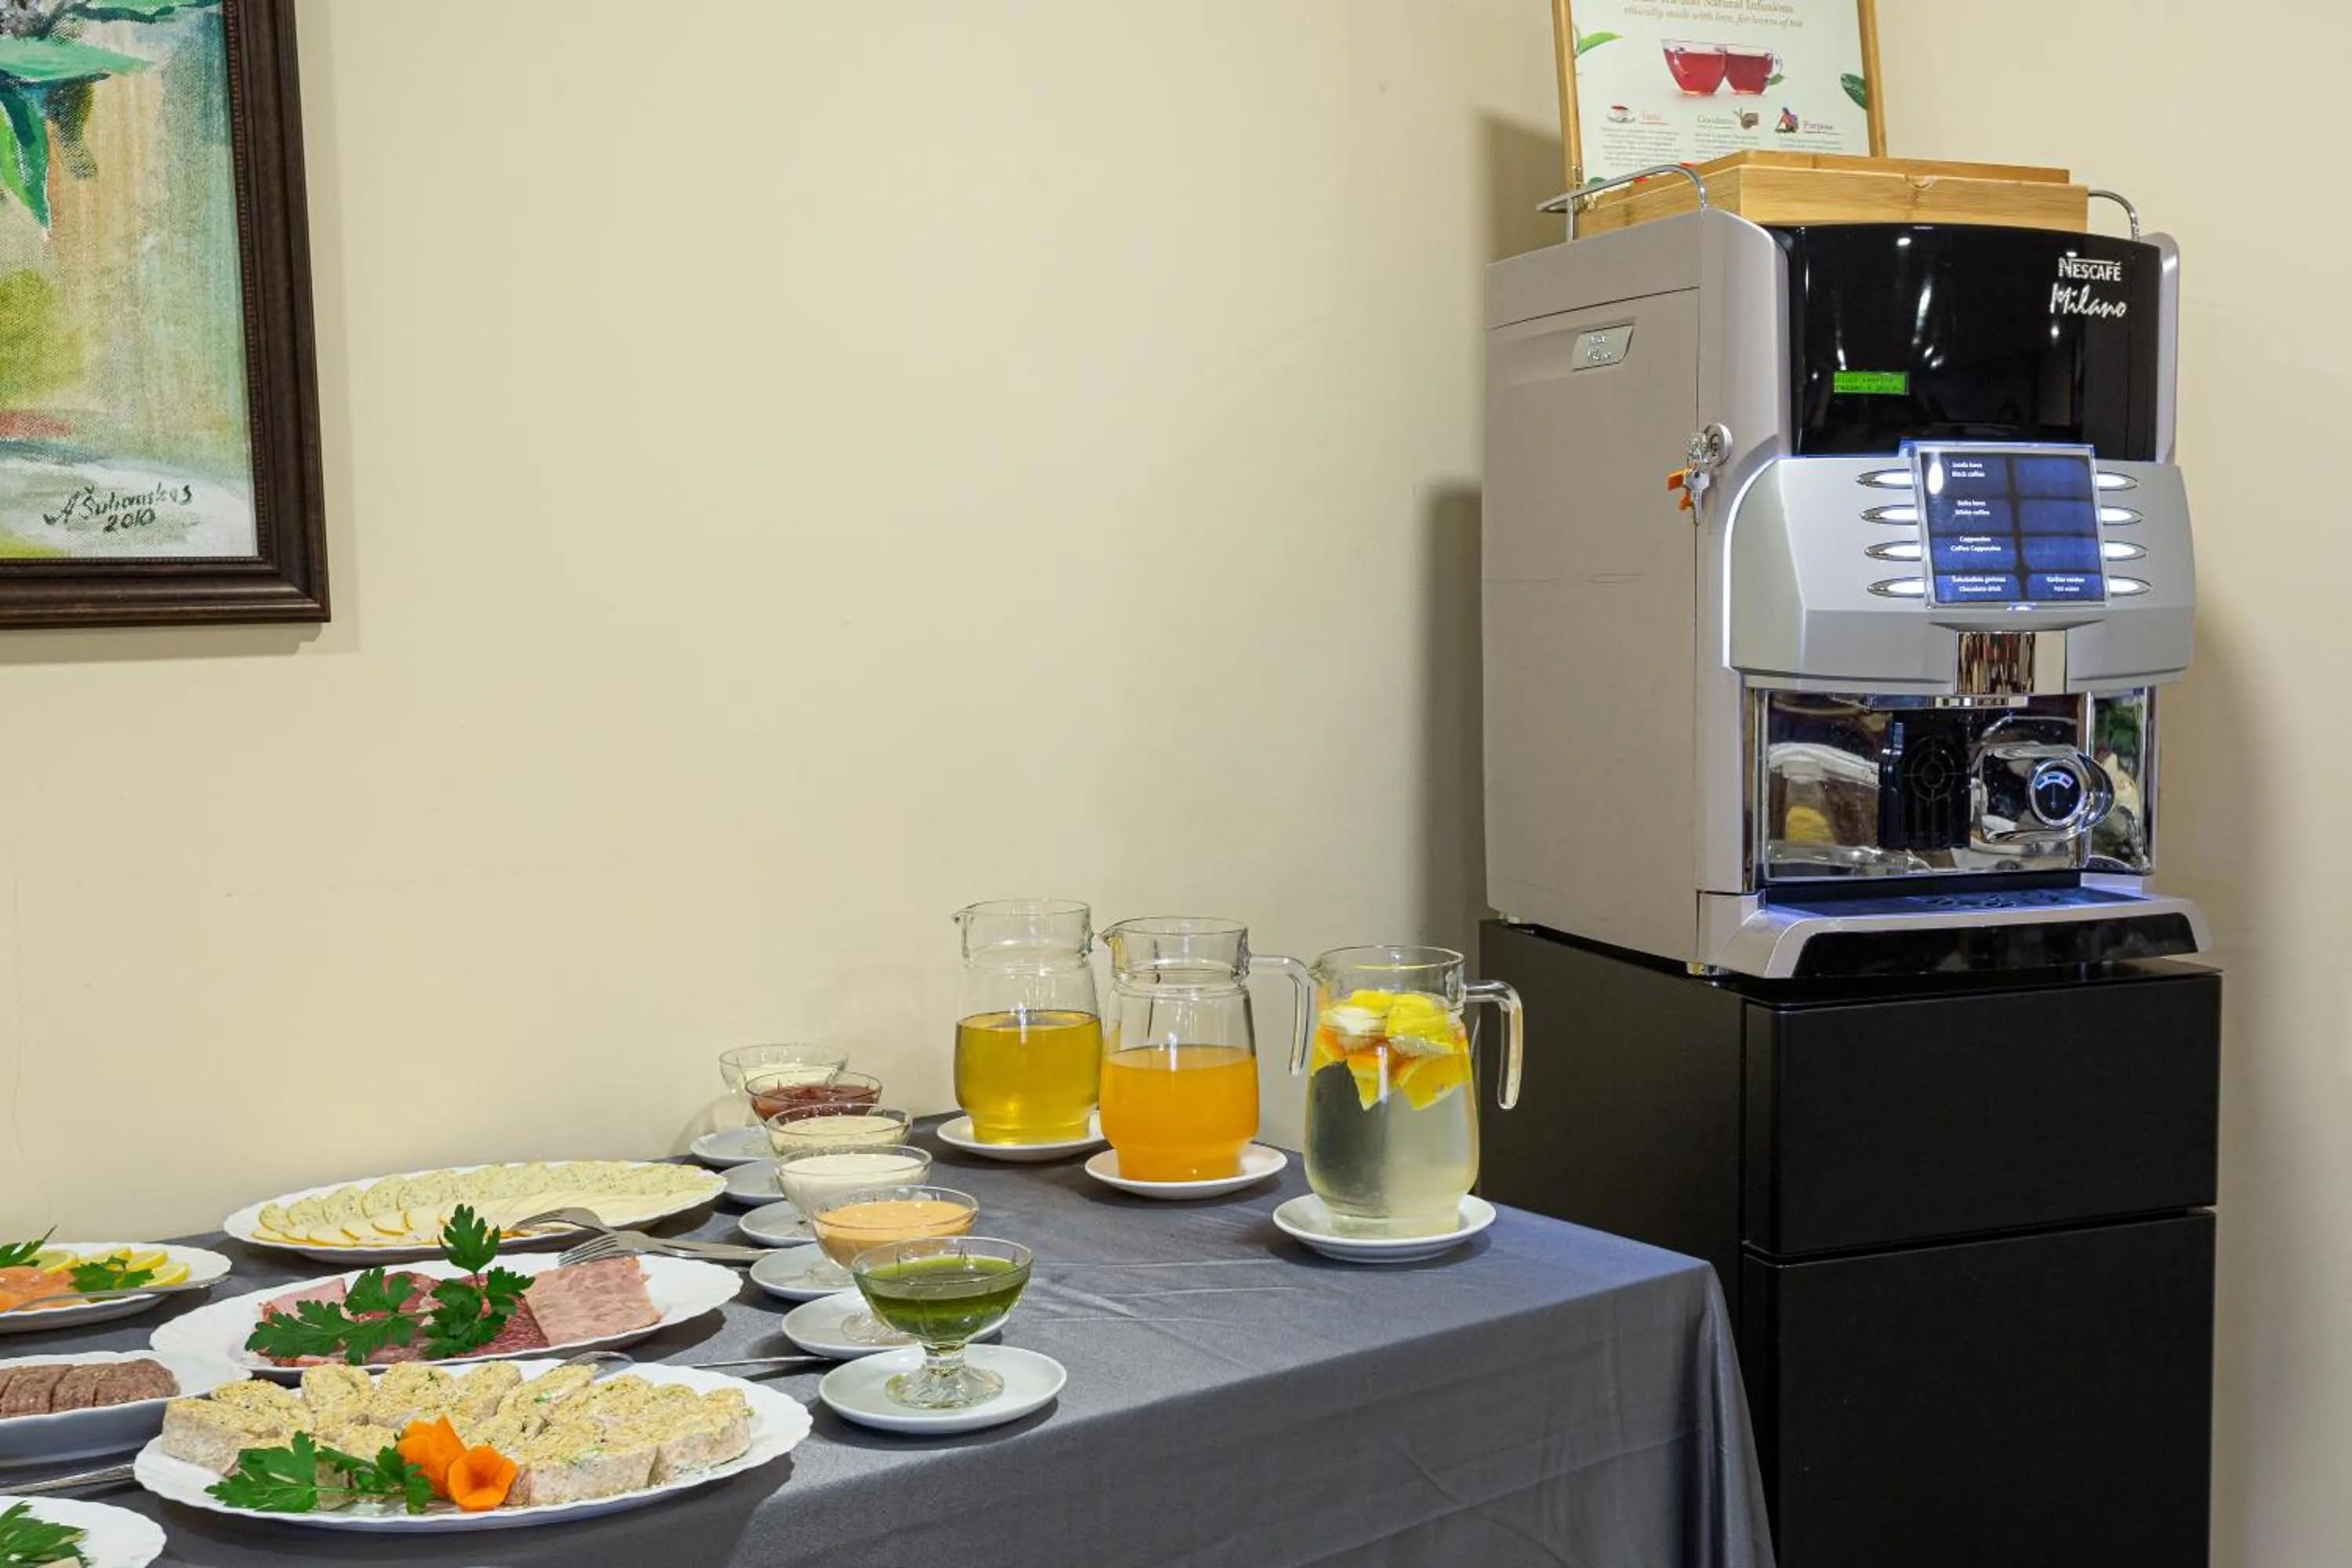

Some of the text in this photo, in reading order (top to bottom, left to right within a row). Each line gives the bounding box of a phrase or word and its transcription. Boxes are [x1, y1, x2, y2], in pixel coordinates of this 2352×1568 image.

[1692, 10, 1713, 20] with
[1747, 0, 1794, 13] Infusions
[2058, 256, 2122, 281] NESCAFÉ
[2049, 283, 2127, 318] Milano
[103, 507, 156, 533] 2010
